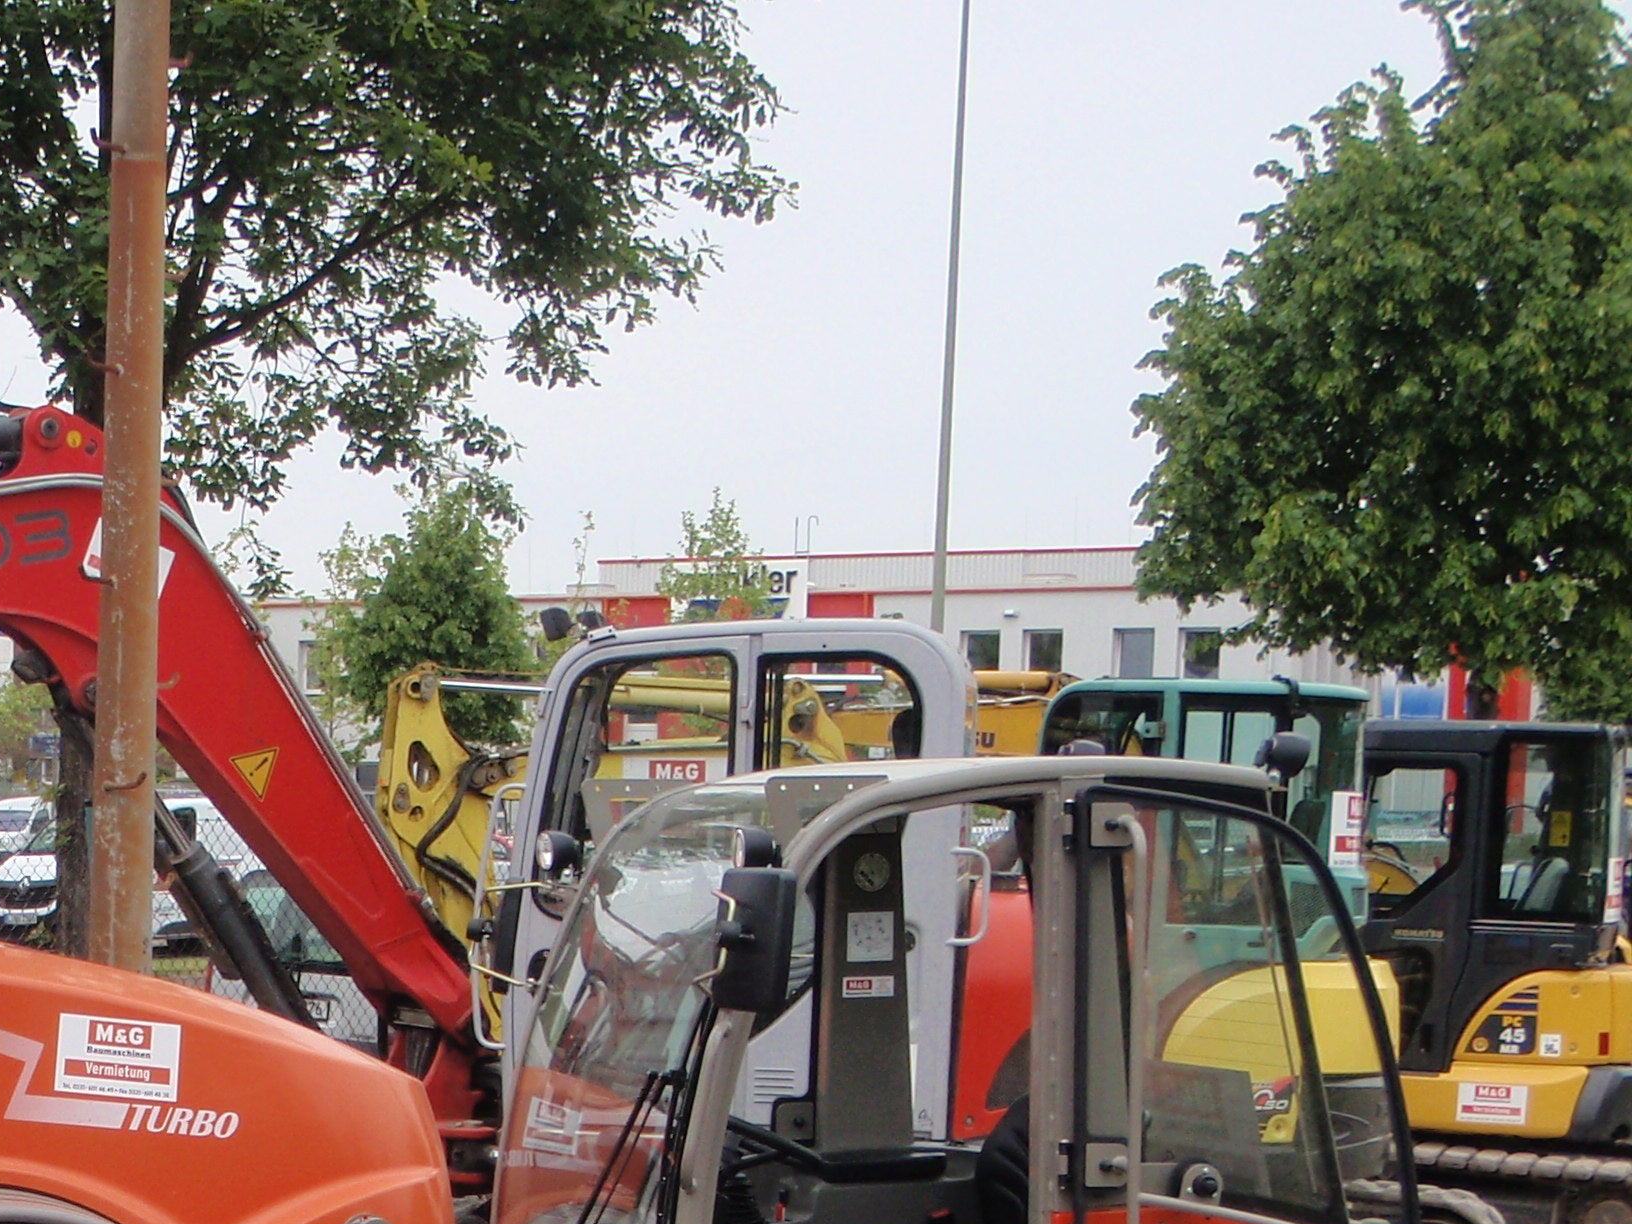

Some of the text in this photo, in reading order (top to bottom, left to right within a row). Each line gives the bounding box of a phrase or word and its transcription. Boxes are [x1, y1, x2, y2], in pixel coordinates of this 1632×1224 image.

[655, 762, 700, 780] M&G
[95, 1022, 145, 1046] M&G
[1499, 1027, 1526, 1043] 45
[86, 1045, 152, 1060] Baumaschinen
[85, 1061, 151, 1082] Vermietung
[129, 1103, 239, 1139] TURBO
